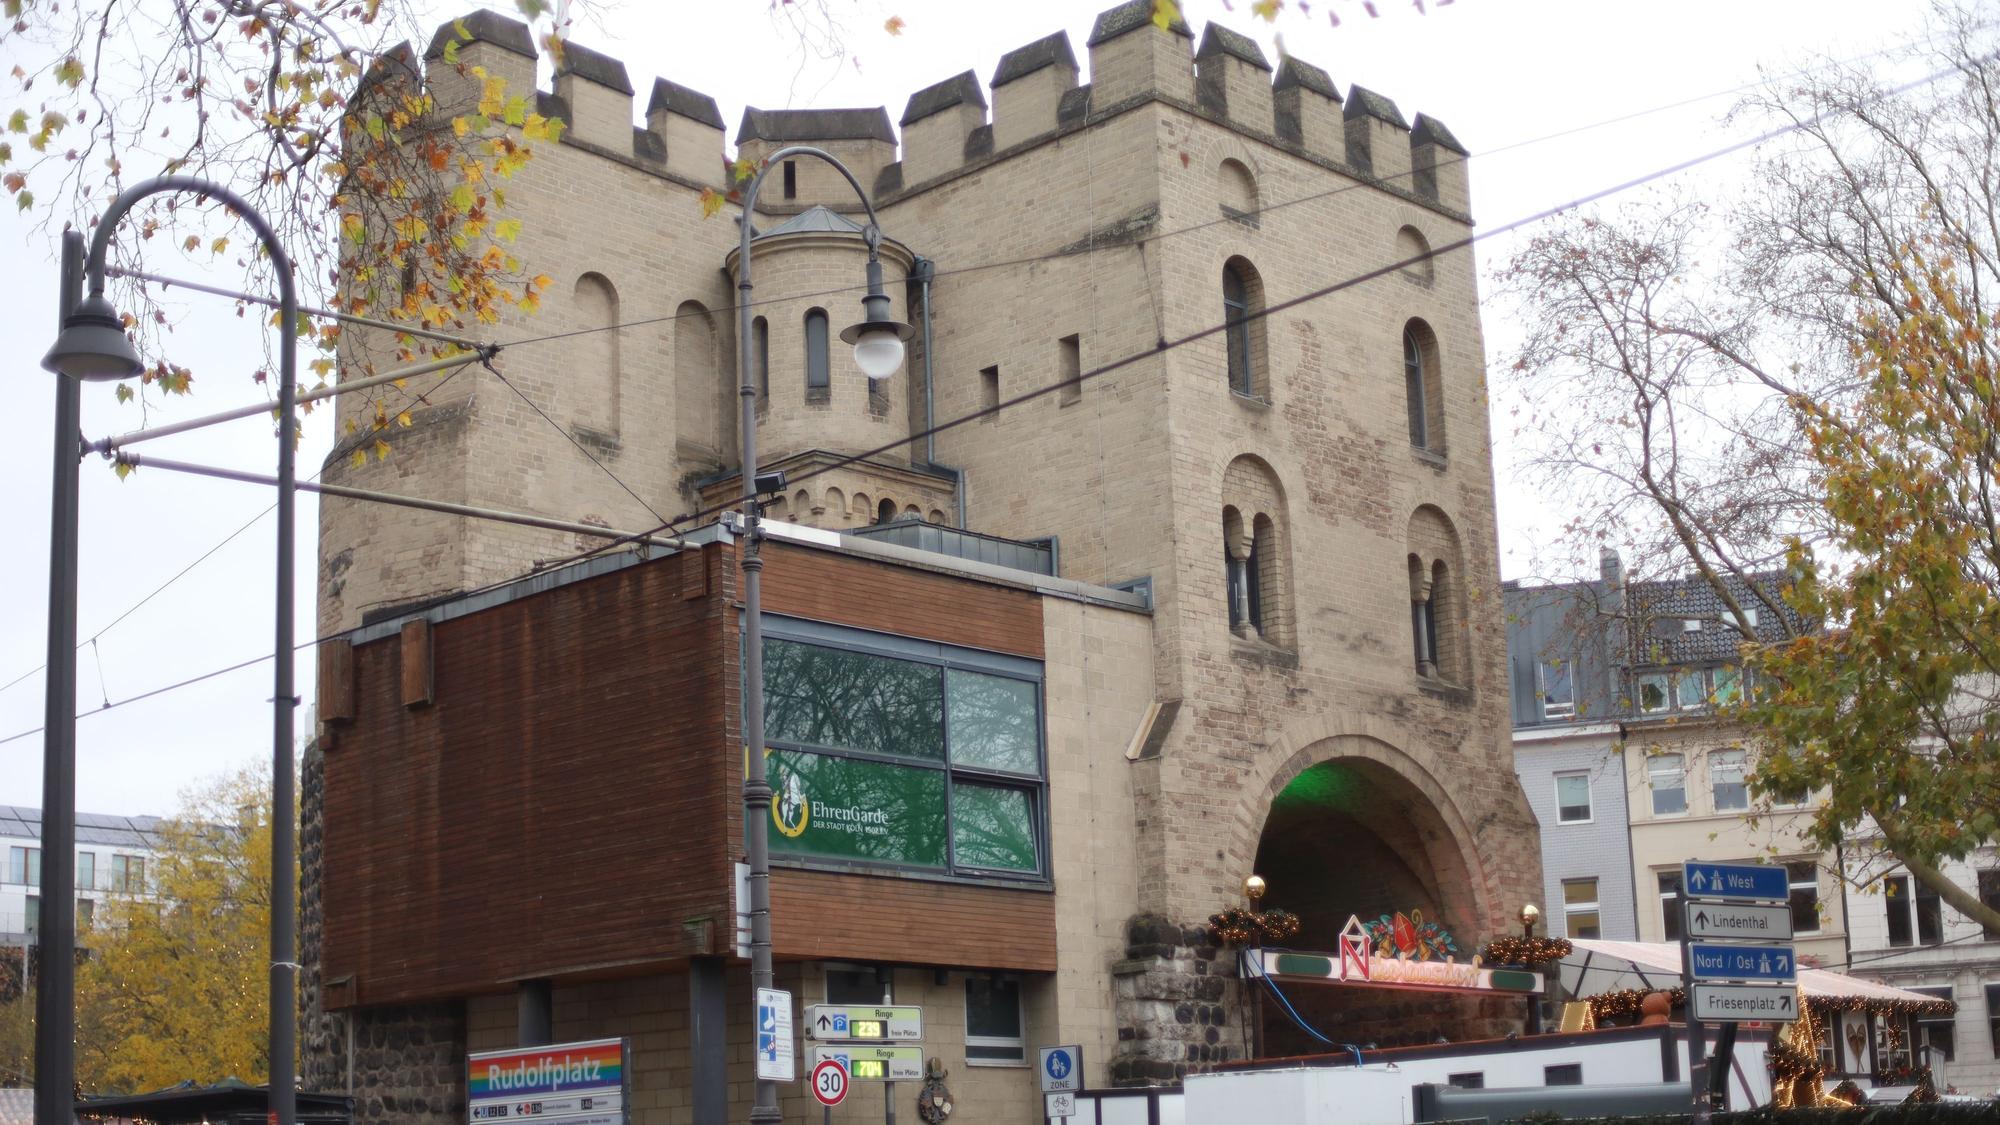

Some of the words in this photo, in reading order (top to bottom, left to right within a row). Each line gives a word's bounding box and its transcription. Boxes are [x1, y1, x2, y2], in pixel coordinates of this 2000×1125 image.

[812, 801, 889, 825] EhrenGarde
[813, 820, 825, 829] DER
[826, 822, 845, 831] STADT
[1727, 874, 1755, 889] West
[1712, 914, 1769, 930] Lindenthal
[1696, 954, 1723, 969] Nord
[1736, 955, 1755, 969] Ost
[1709, 995, 1776, 1013] Friesenplatz
[874, 1009, 894, 1020] Ringe
[876, 1049, 895, 1060] Ringe
[488, 1055, 601, 1091] Rudolfplatz
[819, 1072, 841, 1093] 30
[1050, 1081, 1070, 1090] ZONE
